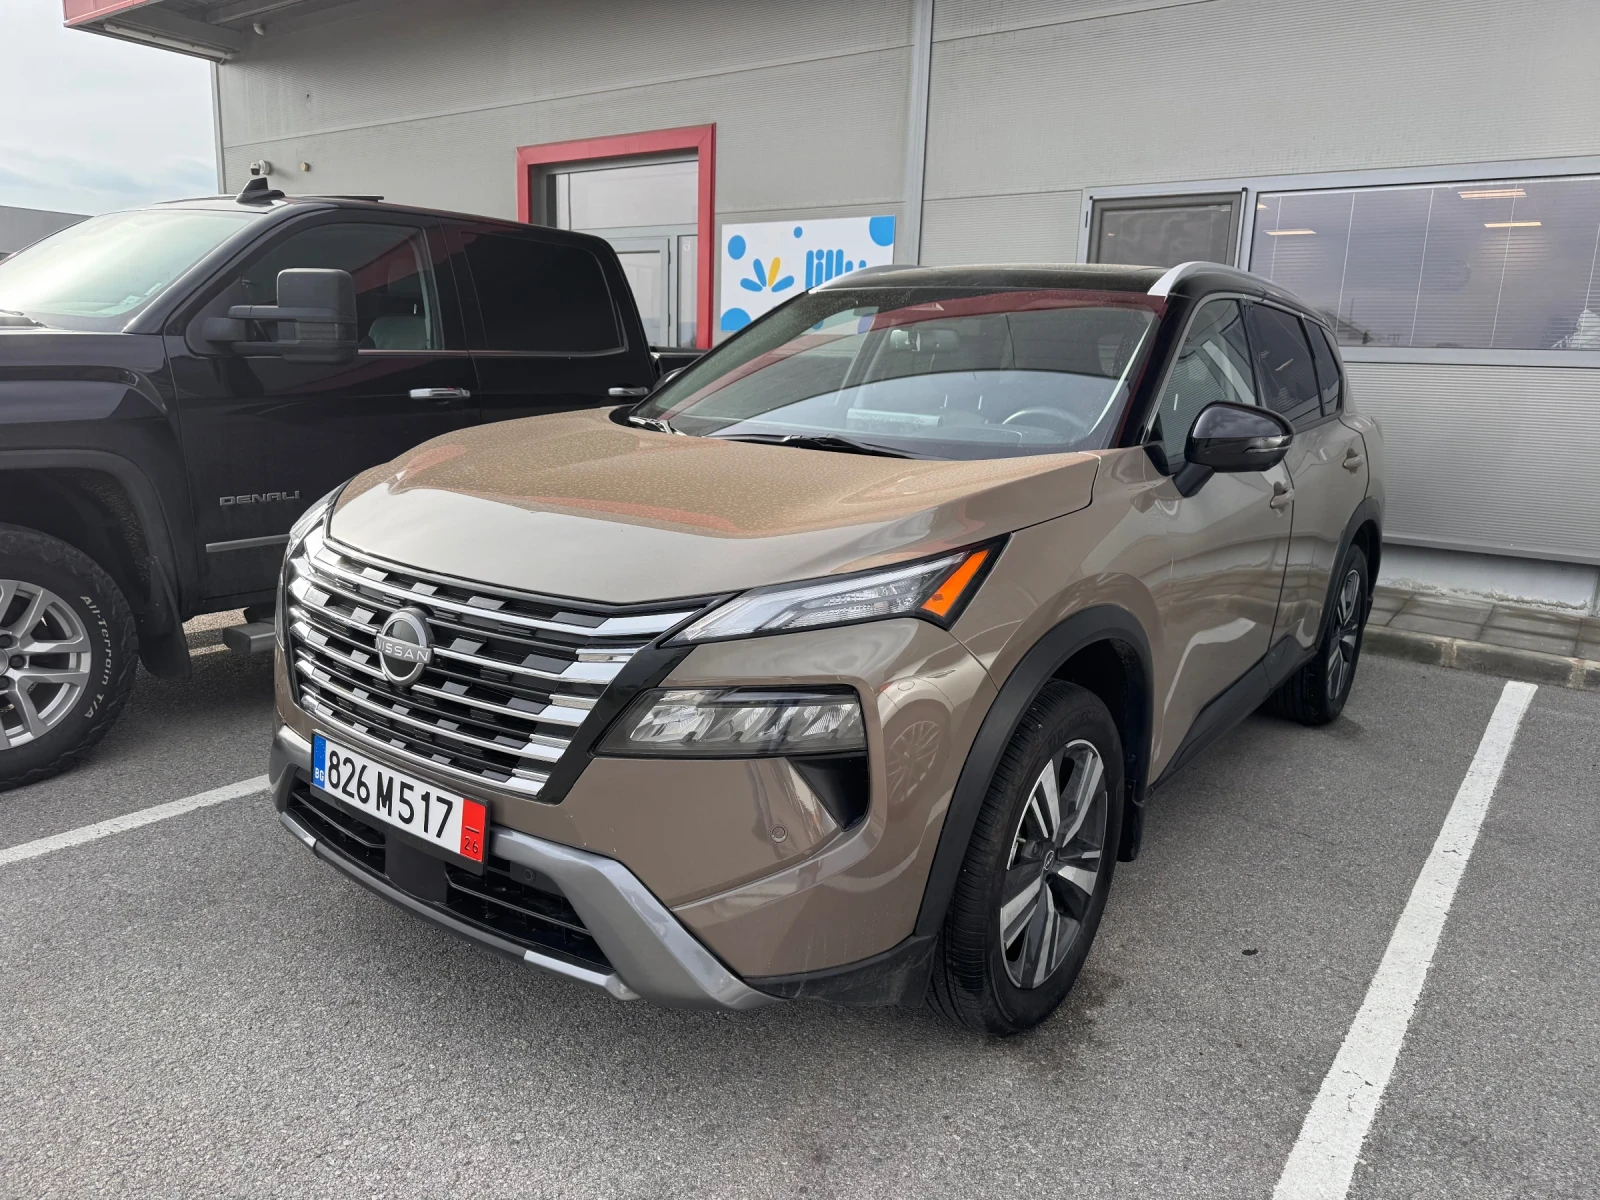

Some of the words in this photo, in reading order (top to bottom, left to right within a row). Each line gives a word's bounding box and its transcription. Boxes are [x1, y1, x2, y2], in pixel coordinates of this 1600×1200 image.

[219, 490, 300, 506] DENALI
[80, 595, 113, 686] All-Terrain
[375, 636, 430, 662] NISSAN
[84, 693, 105, 718] T/A
[314, 767, 325, 782] BG
[464, 835, 479, 854] 26
